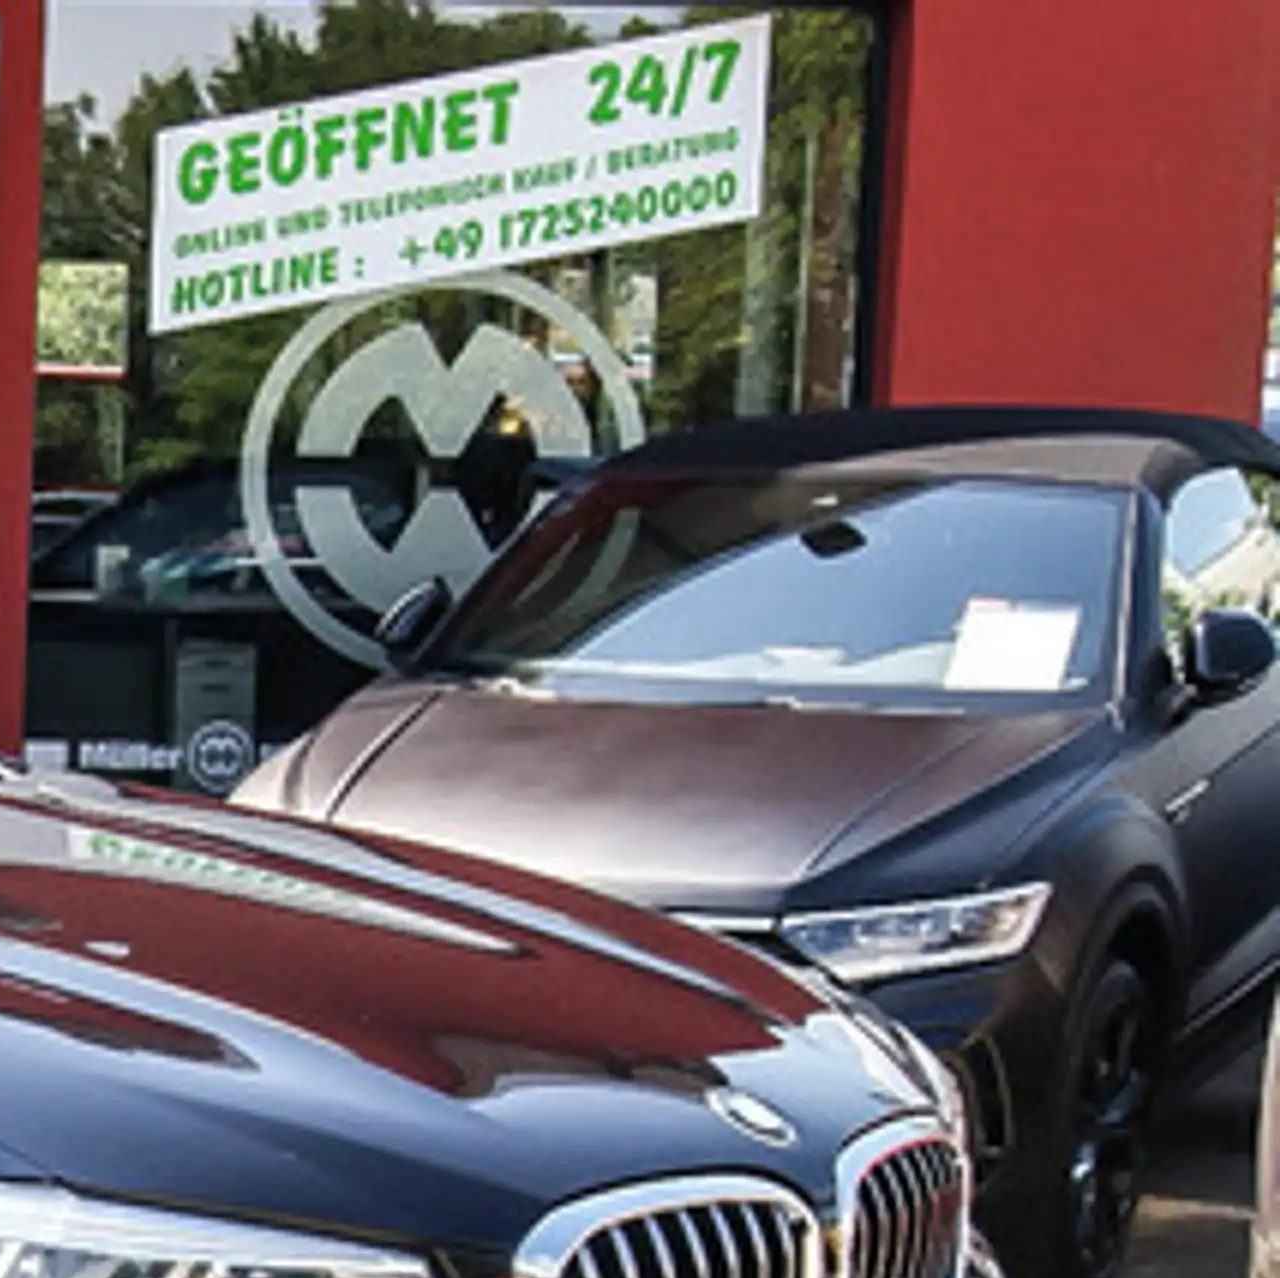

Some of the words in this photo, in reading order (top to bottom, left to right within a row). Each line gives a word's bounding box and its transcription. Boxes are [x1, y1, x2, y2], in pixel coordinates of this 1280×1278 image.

[174, 218, 266, 259] ONLINE
[276, 205, 330, 238] UND
[339, 173, 505, 227] TELEFONISCH
[512, 157, 576, 193] KAUF
[606, 125, 740, 175] BERATUNG
[178, 80, 519, 205] GEÖFFNET
[587, 39, 741, 125] 24/7
[171, 246, 340, 315] HOTLINE
[399, 219, 484, 266] +49
[499, 168, 737, 250] 1725240000
